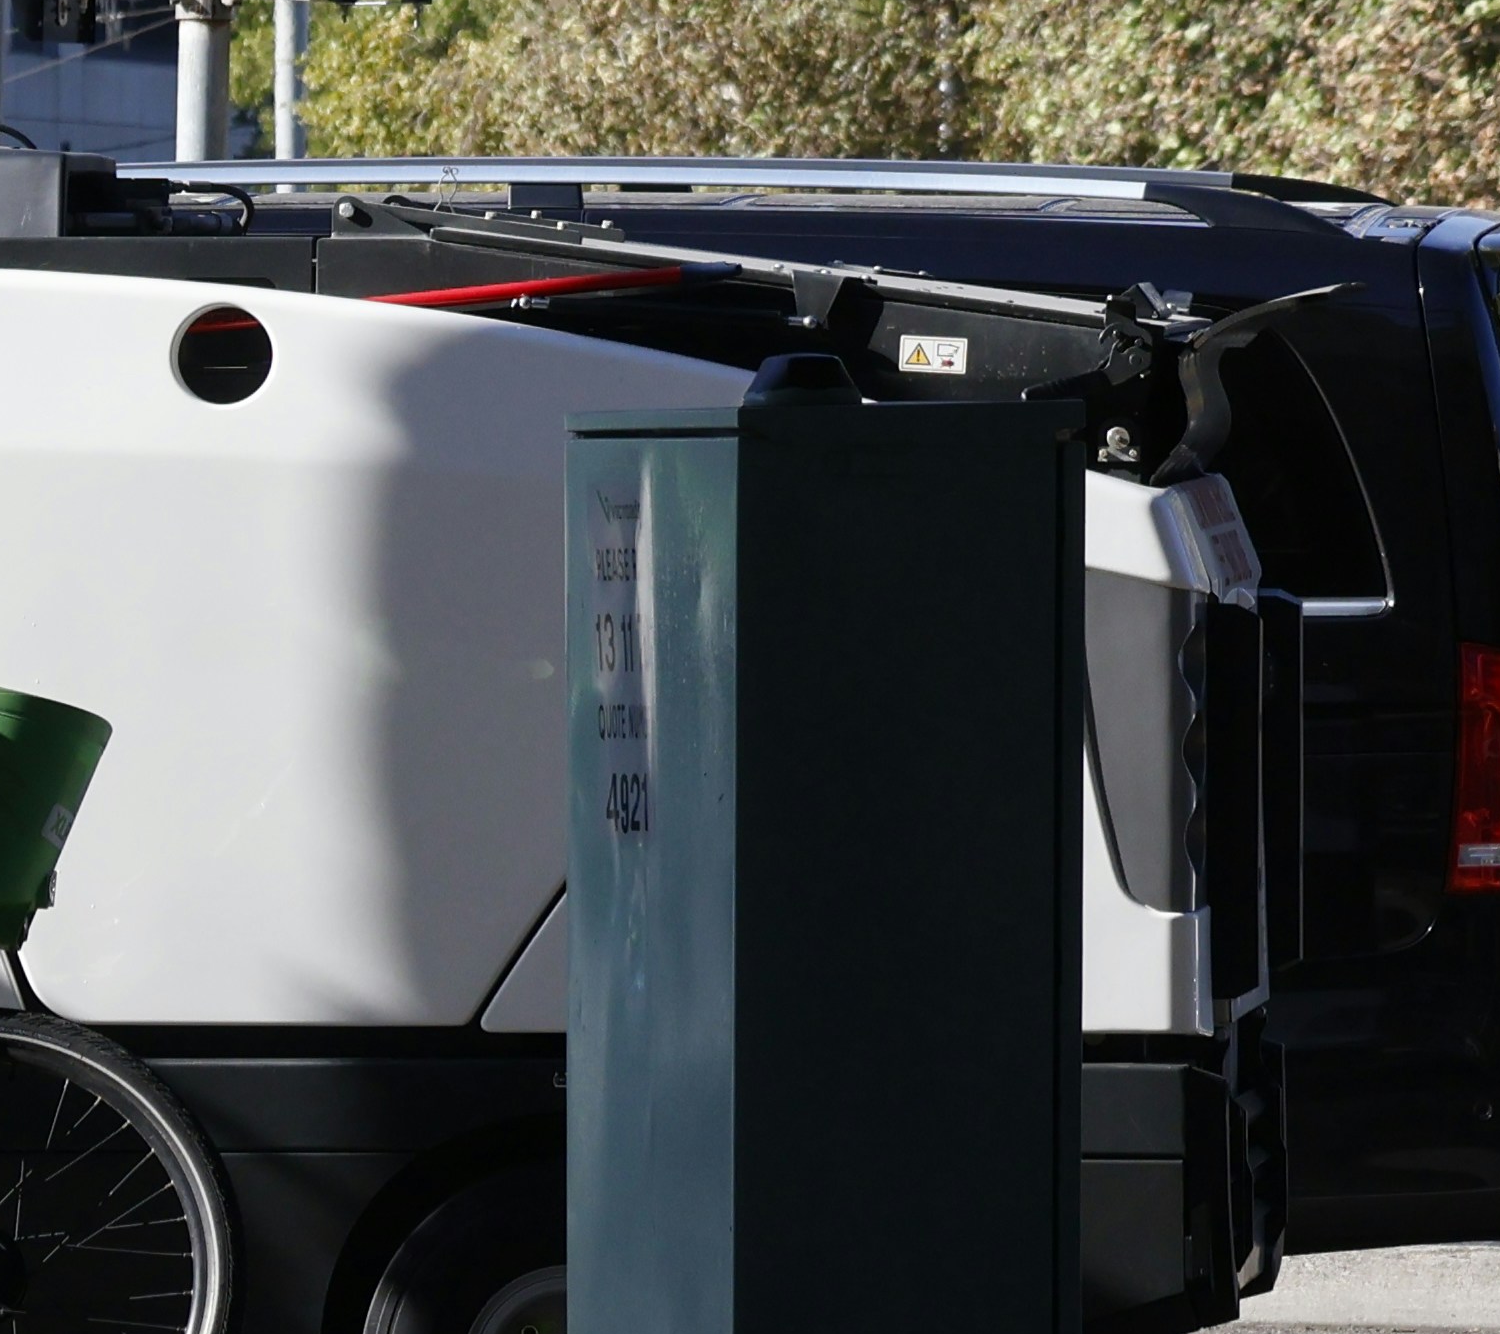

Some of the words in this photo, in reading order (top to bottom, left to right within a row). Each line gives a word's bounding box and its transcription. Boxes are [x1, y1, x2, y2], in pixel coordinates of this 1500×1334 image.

[596, 548, 630, 581] PLEASE
[596, 613, 615, 672] 13
[599, 704, 626, 740] QUOTE
[606, 772, 648, 833] 4921
